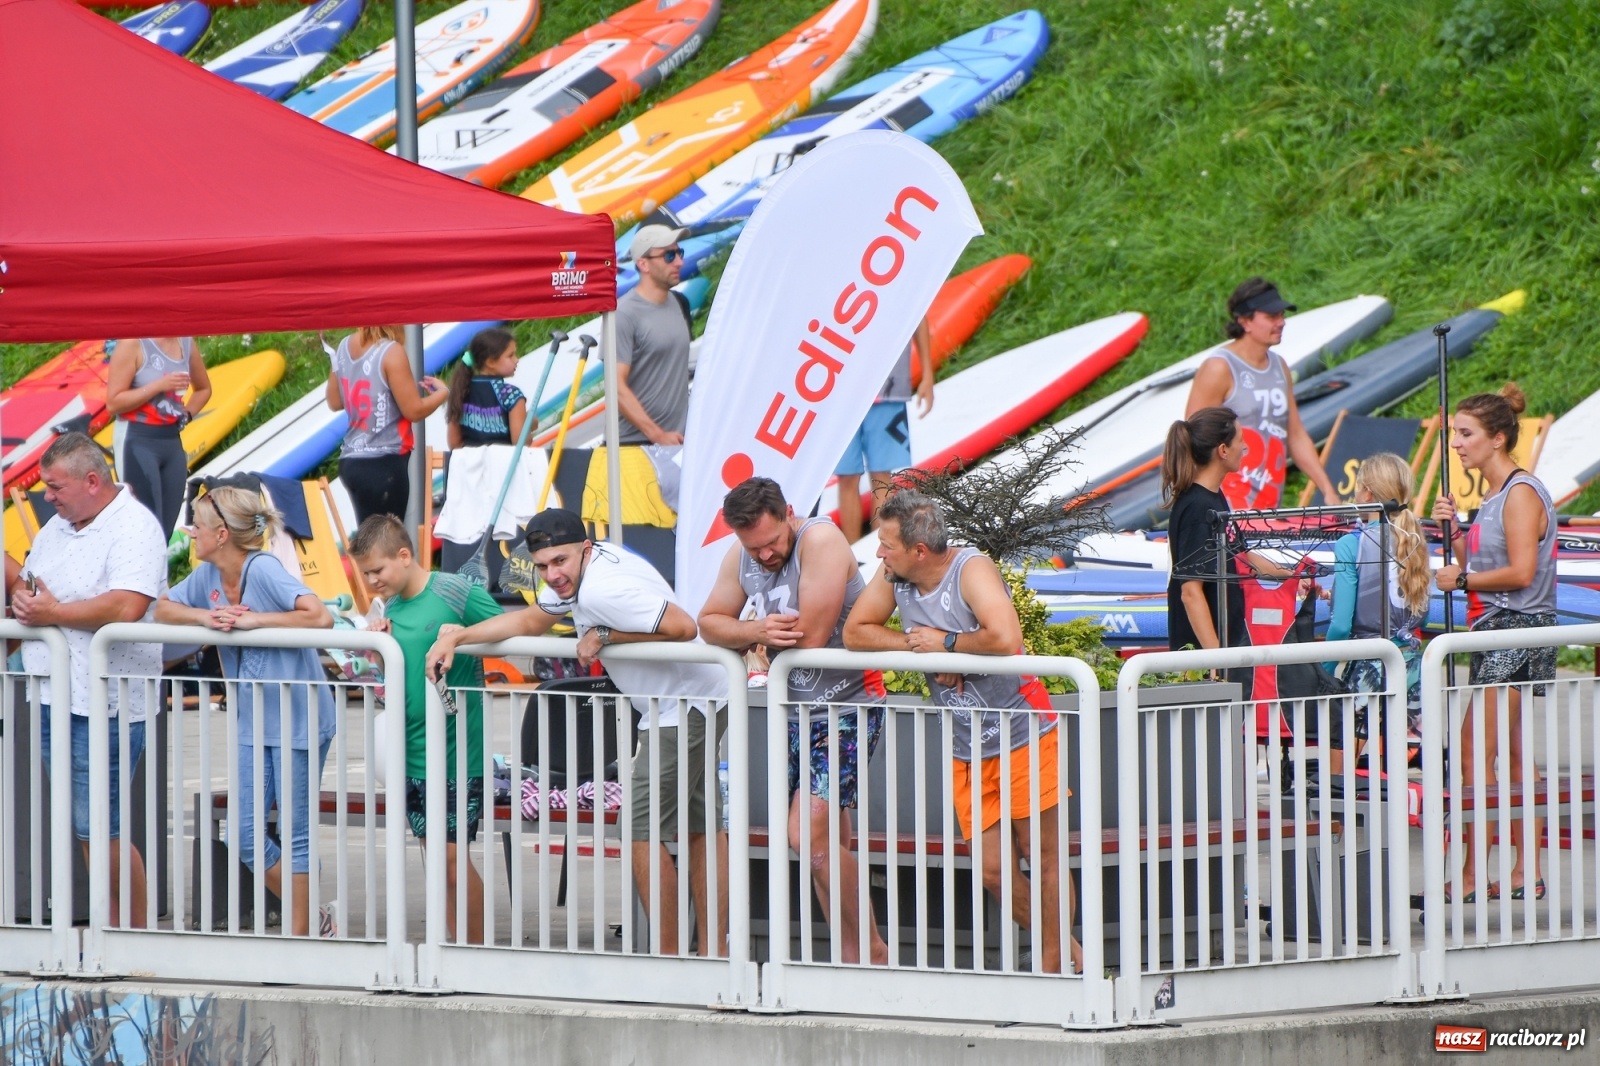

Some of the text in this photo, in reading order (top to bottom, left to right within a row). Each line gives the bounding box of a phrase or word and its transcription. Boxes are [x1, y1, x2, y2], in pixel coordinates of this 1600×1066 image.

[153, 3, 181, 25] PRO
[657, 34, 701, 77] WATTSUP
[974, 69, 1026, 115] WATTSUP
[551, 270, 587, 287] BRIMO
[754, 185, 940, 461] Edison
[371, 392, 387, 433] intex
[1253, 387, 1288, 418] 79
[1241, 465, 1274, 491] sup
[1100, 613, 1141, 634] AM
